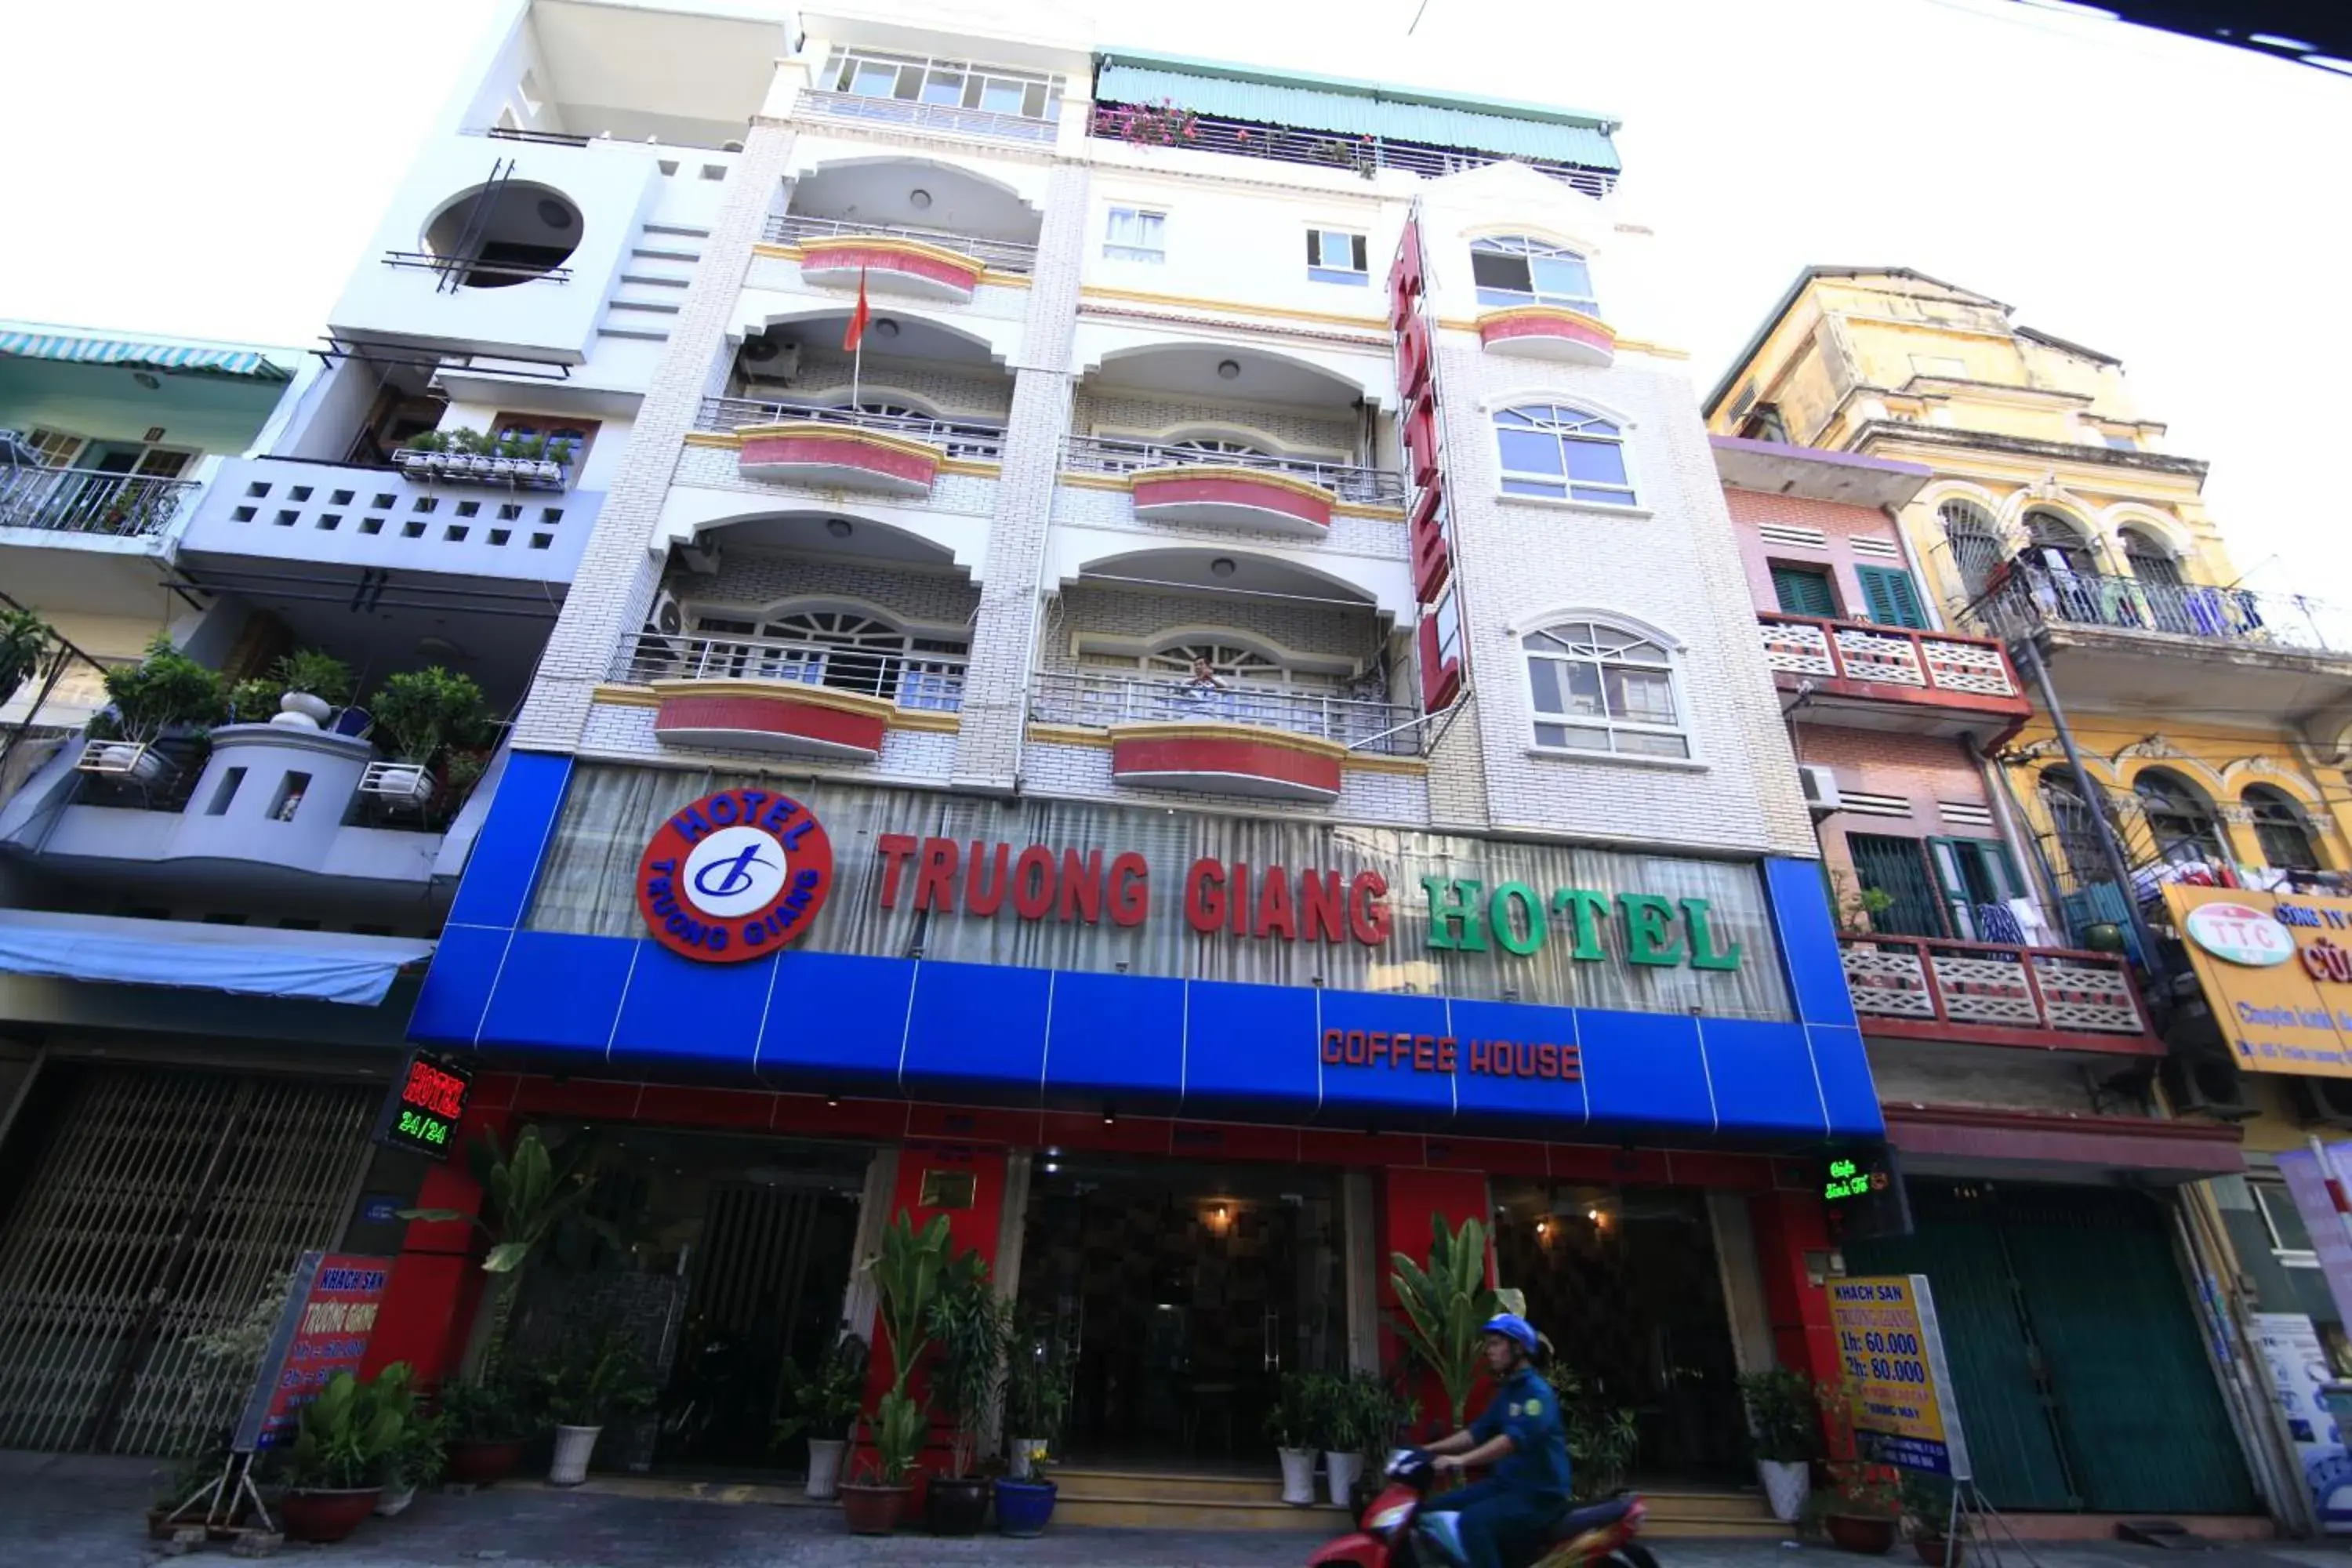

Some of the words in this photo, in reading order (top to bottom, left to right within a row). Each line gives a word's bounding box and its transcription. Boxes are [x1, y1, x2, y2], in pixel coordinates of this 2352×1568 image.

[1390, 220, 1461, 716] HOTEL
[672, 789, 815, 851] HOTEL
[646, 858, 731, 951] TRUONG
[742, 868, 819, 946] GIANG
[878, 833, 1149, 927] TRUONG
[1184, 857, 1392, 946] GIANG
[1420, 875, 1743, 972] HOTEL
[1321, 1029, 1457, 1073] COFFEE
[1470, 1040, 1582, 1081] HOUSE
[402, 1061, 466, 1120] HOTEL
[398, 1111, 448, 1145] 24/24
[1841, 1331, 1863, 1352] 1h:
[1865, 1331, 1918, 1356] 60.000
[1846, 1356, 1868, 1381] 2h:
[1871, 1357, 1926, 1384] 80.000
